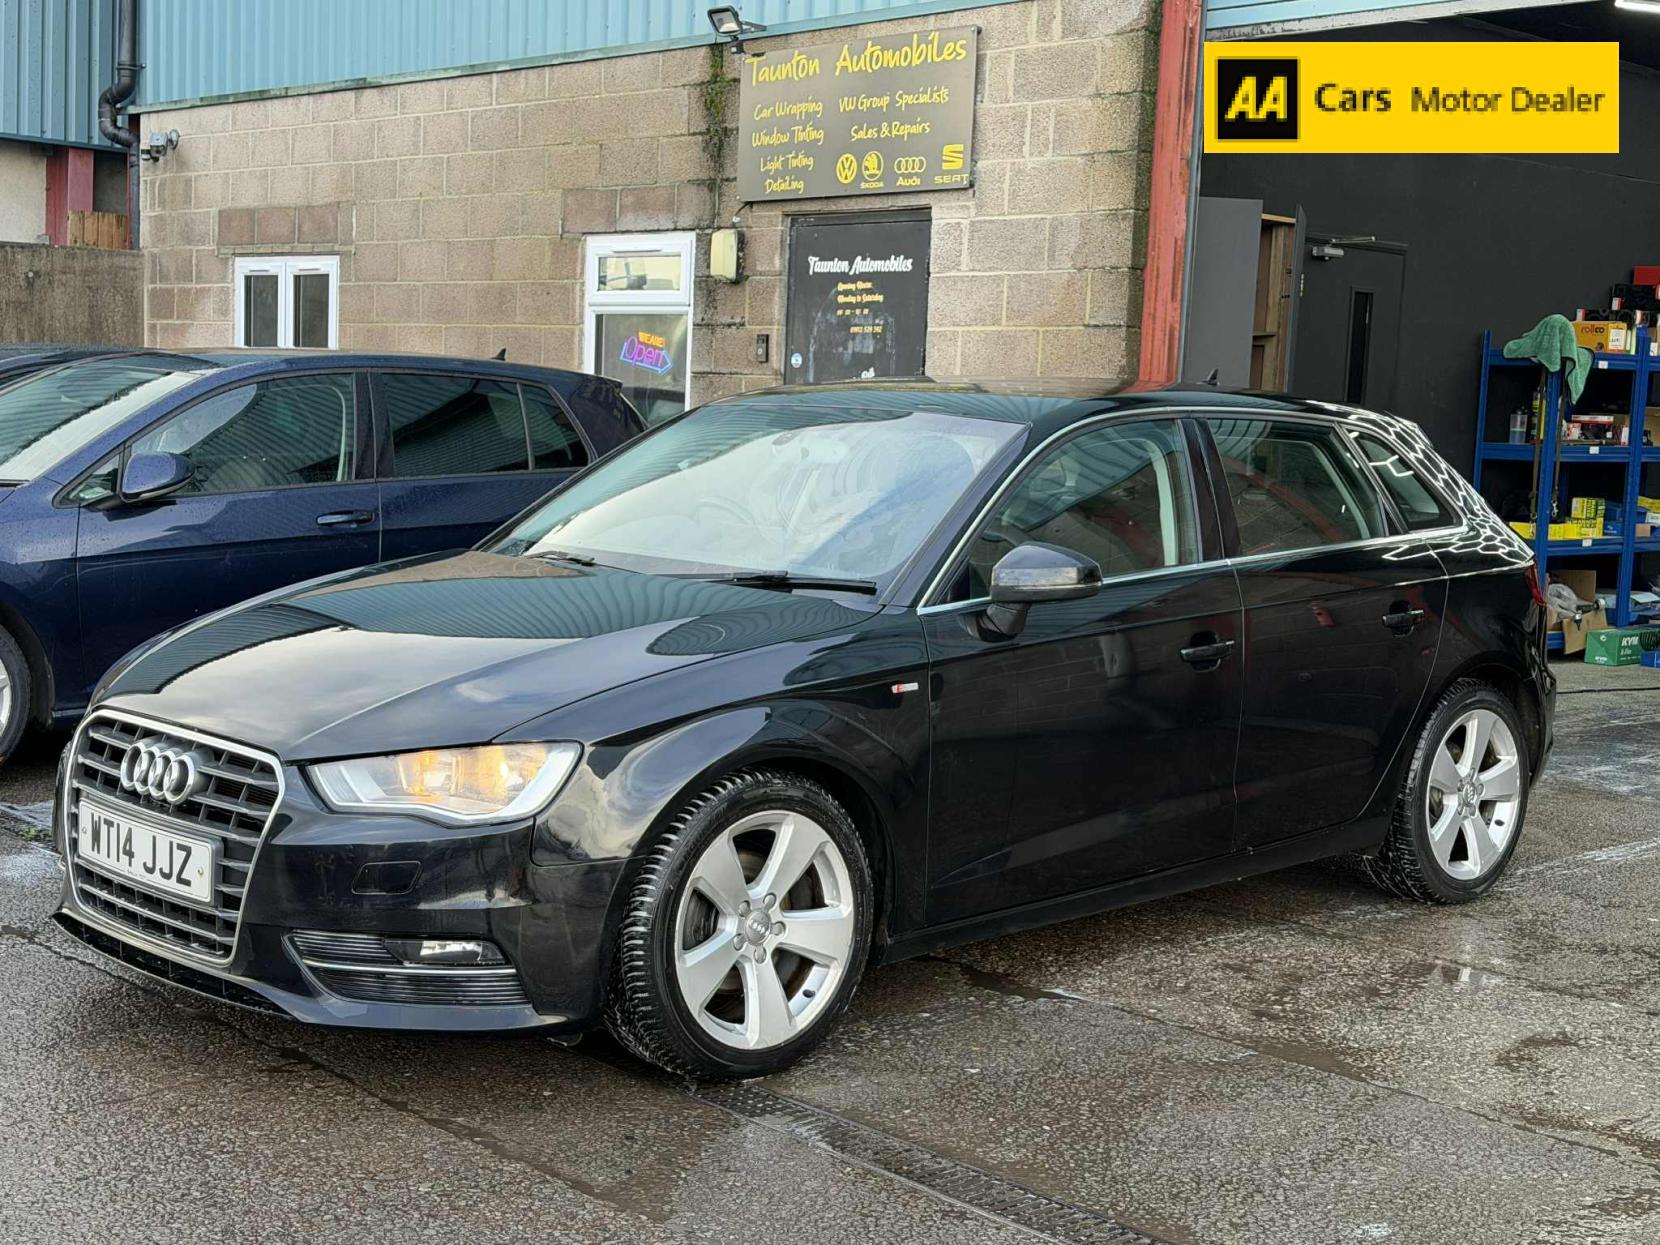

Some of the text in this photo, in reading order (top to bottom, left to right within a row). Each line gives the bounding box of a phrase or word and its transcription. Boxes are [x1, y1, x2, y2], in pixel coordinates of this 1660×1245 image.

[745, 31, 968, 86] Taunton Automobiles
[753, 96, 823, 121] Car Wrapping
[839, 86, 950, 114] VW Group Specialists
[752, 121, 824, 148] Window Tinting
[850, 118, 931, 142] Sales & Repairs
[760, 149, 814, 172] Light Tinting
[764, 177, 804, 195] Detailing
[896, 176, 921, 186] Audi
[934, 174, 969, 184] SEAT
[808, 254, 913, 275] Taunton Automobiles
[1581, 324, 1605, 334] rollco
[625, 336, 664, 367] Open
[91, 812, 192, 888] WT14 JJZ
